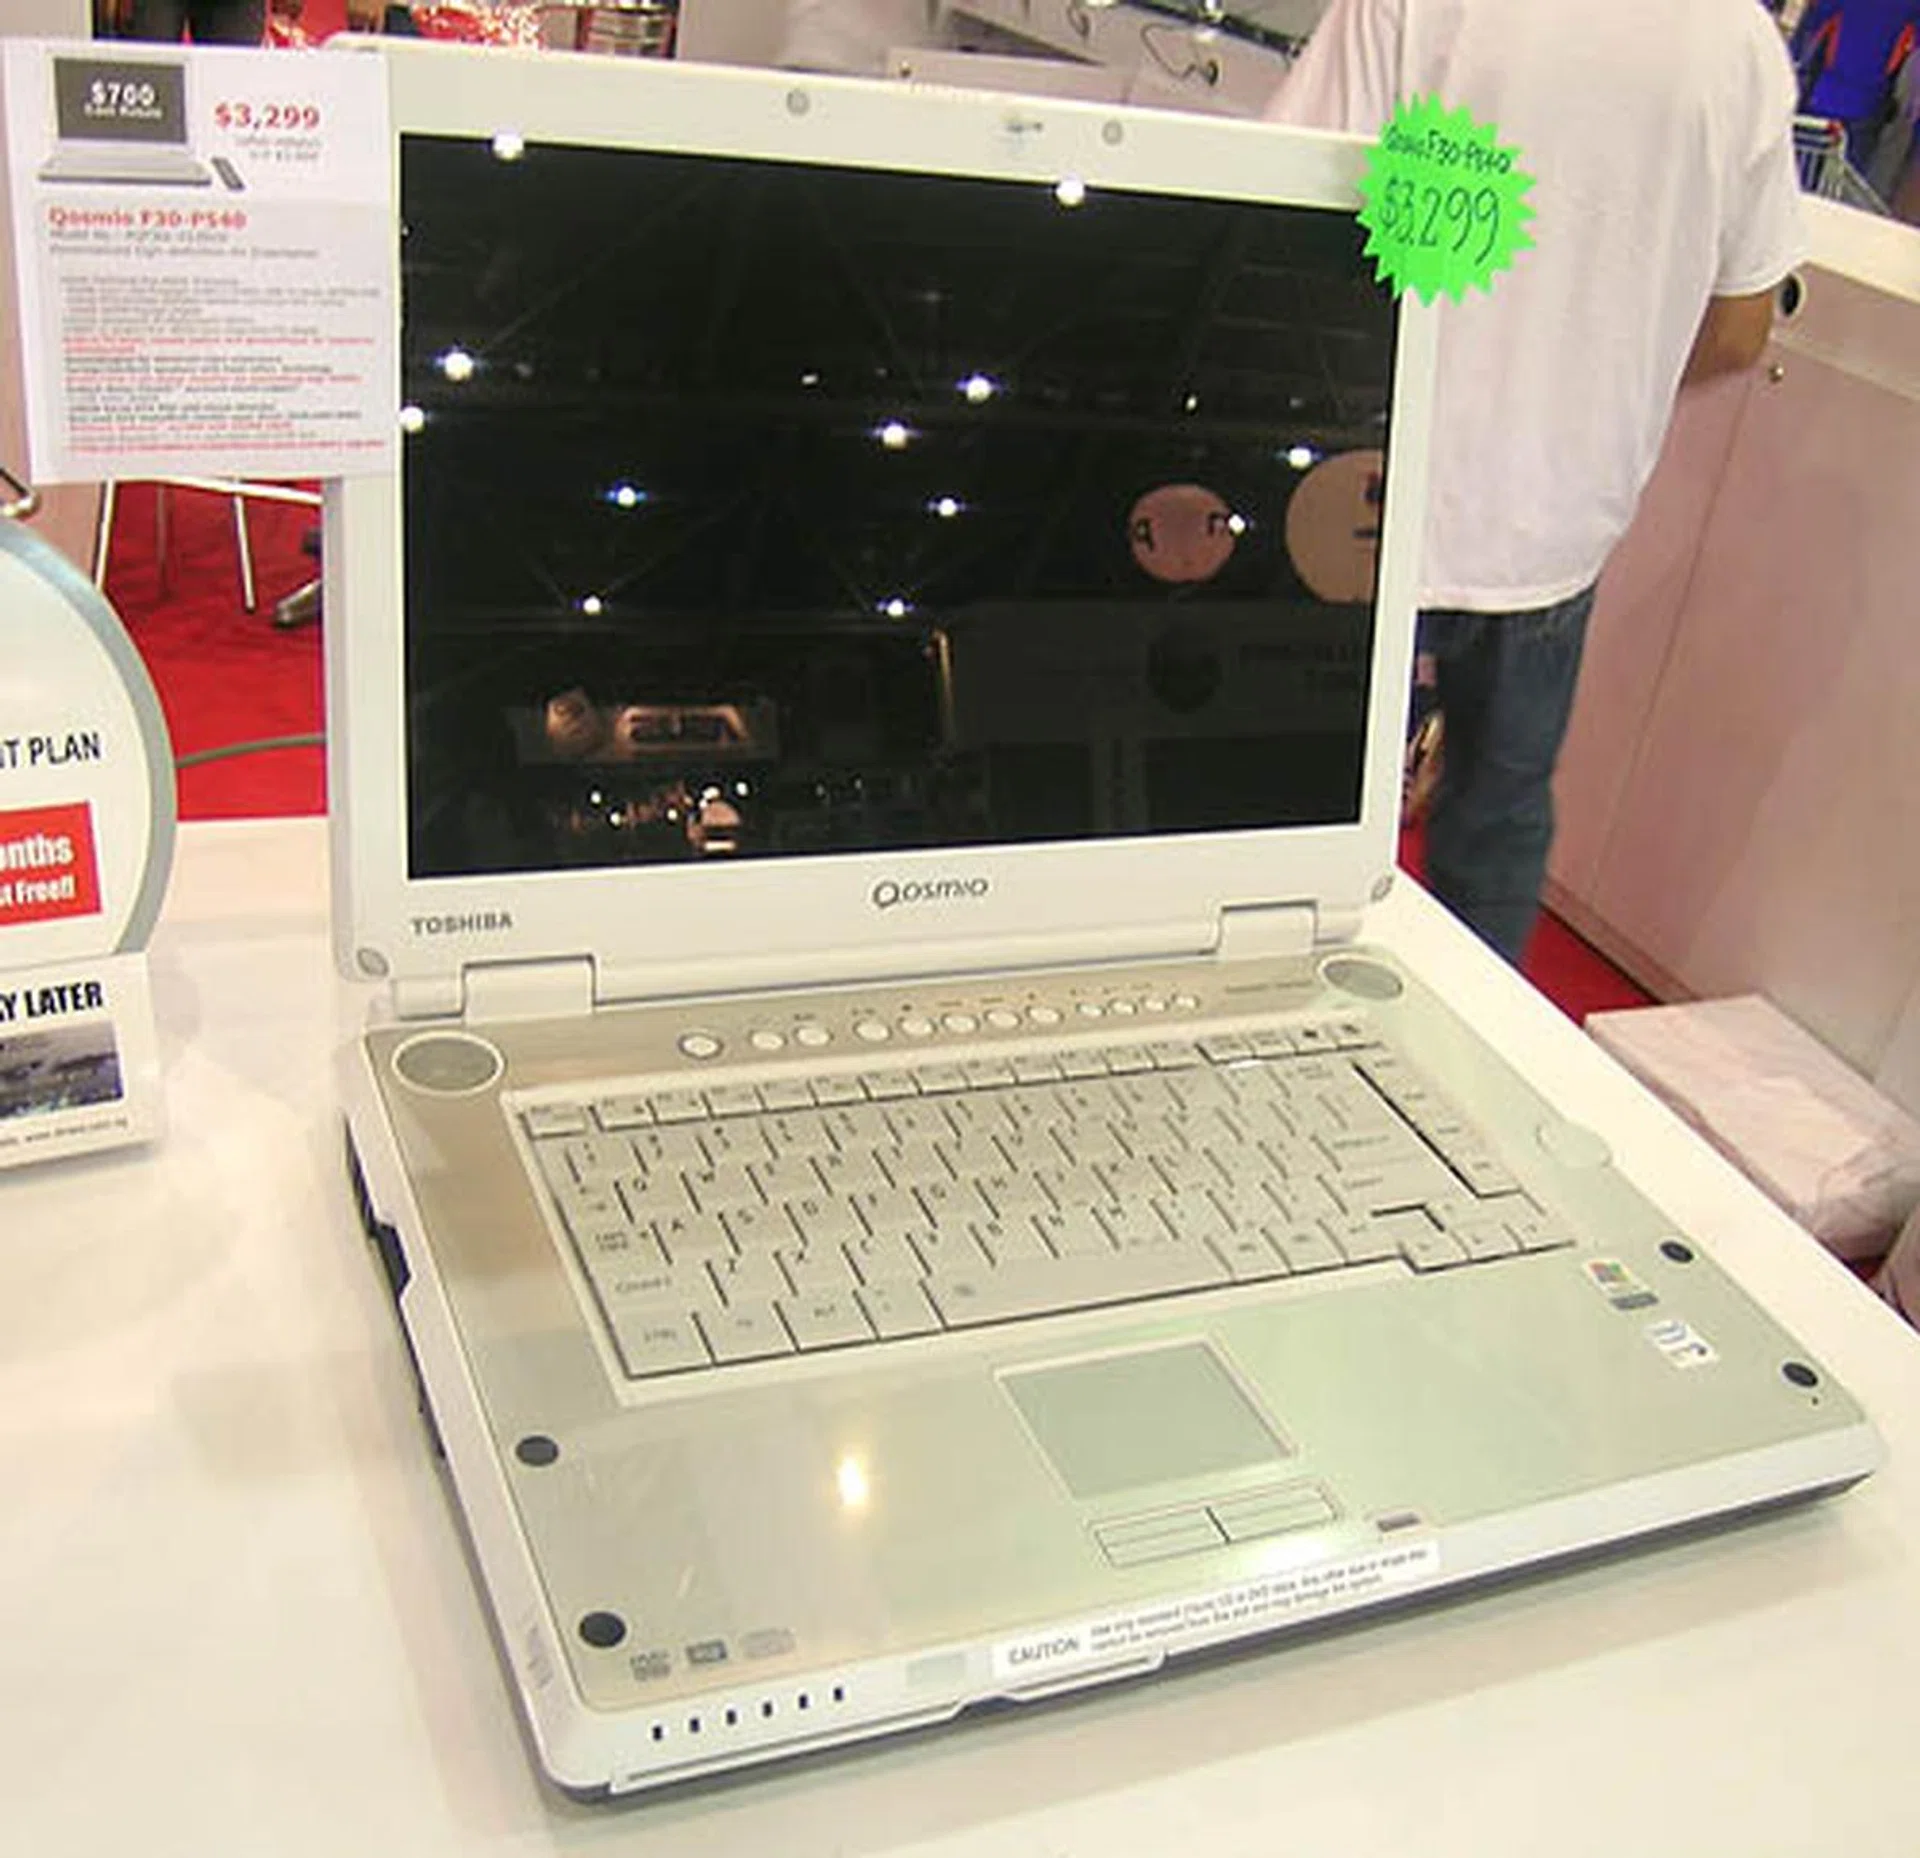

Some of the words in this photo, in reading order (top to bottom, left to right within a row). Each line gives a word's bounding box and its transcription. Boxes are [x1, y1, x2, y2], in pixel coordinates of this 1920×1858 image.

[91, 79, 156, 107] $700
[214, 102, 321, 129] $3,299
[48, 207, 134, 228] Qosmio
[29, 731, 102, 766] PLAN
[411, 912, 513, 935] TOSHIBA
[24, 981, 104, 1018] LATER
[1007, 1636, 1080, 1665] CAUTION
